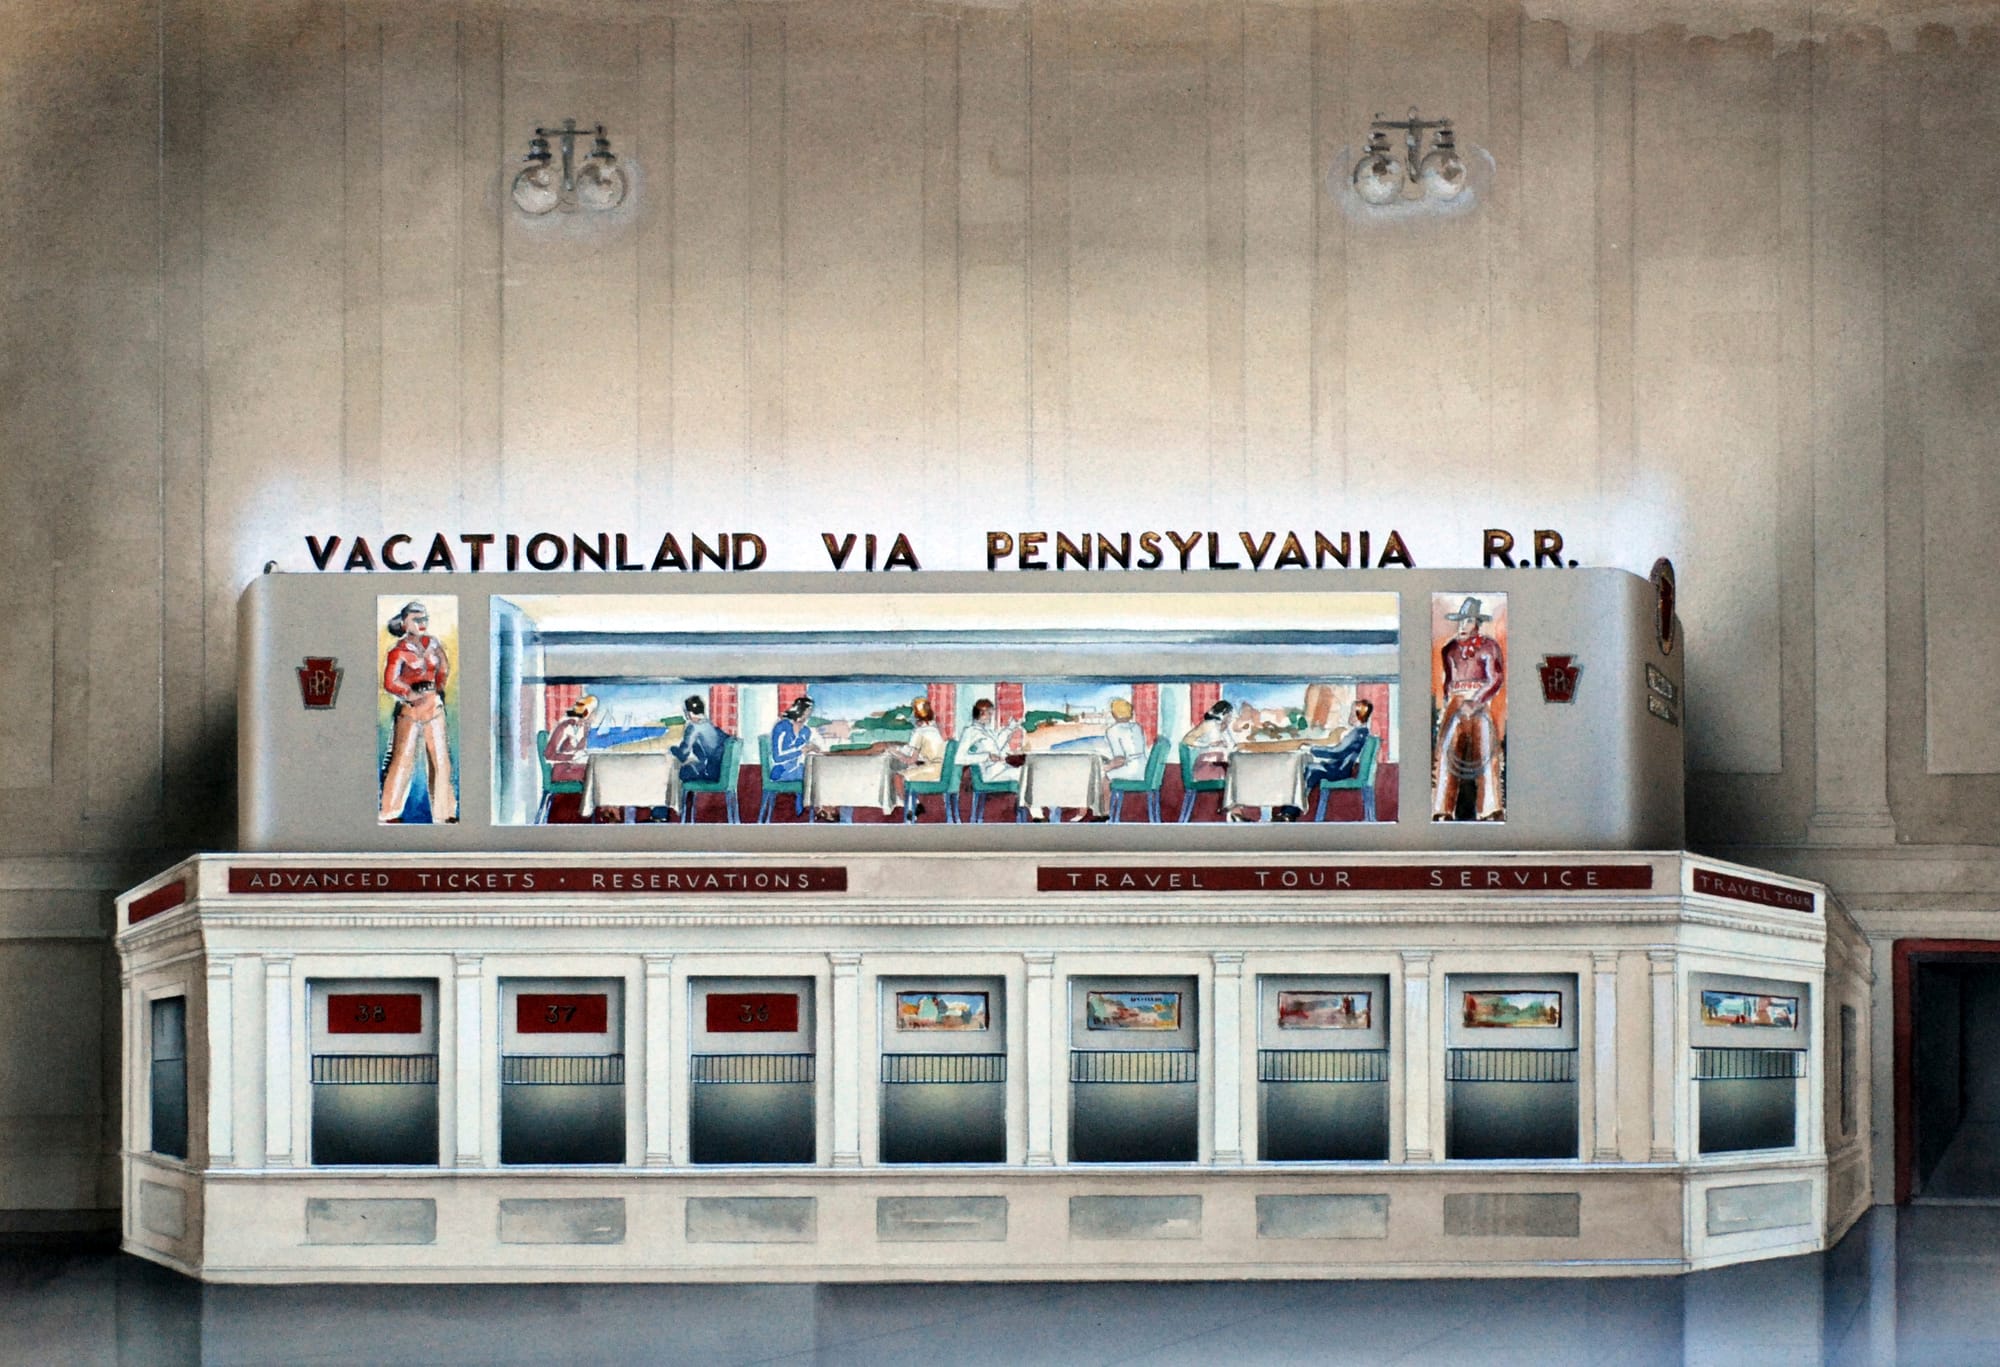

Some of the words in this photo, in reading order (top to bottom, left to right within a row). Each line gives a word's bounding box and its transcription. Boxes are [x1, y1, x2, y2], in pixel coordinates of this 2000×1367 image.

[304, 532, 768, 573] VACATIONLAND
[821, 532, 923, 573] VIA
[986, 530, 1415, 571] PENNSYLVANIA
[1482, 528, 1579, 569] R.R.
[249, 871, 391, 889] ADVANCED
[418, 871, 536, 889] TICKETS
[592, 870, 811, 889] RESERVATIONS
[1066, 871, 1204, 889] TRAVEL
[1255, 870, 1352, 888] TOUR
[1430, 869, 1602, 888] SERVICE
[1700, 875, 1771, 901] TRAVEL
[1775, 891, 1813, 908] TOUR
[356, 1004, 385, 1023] 38
[545, 1004, 576, 1023] 37
